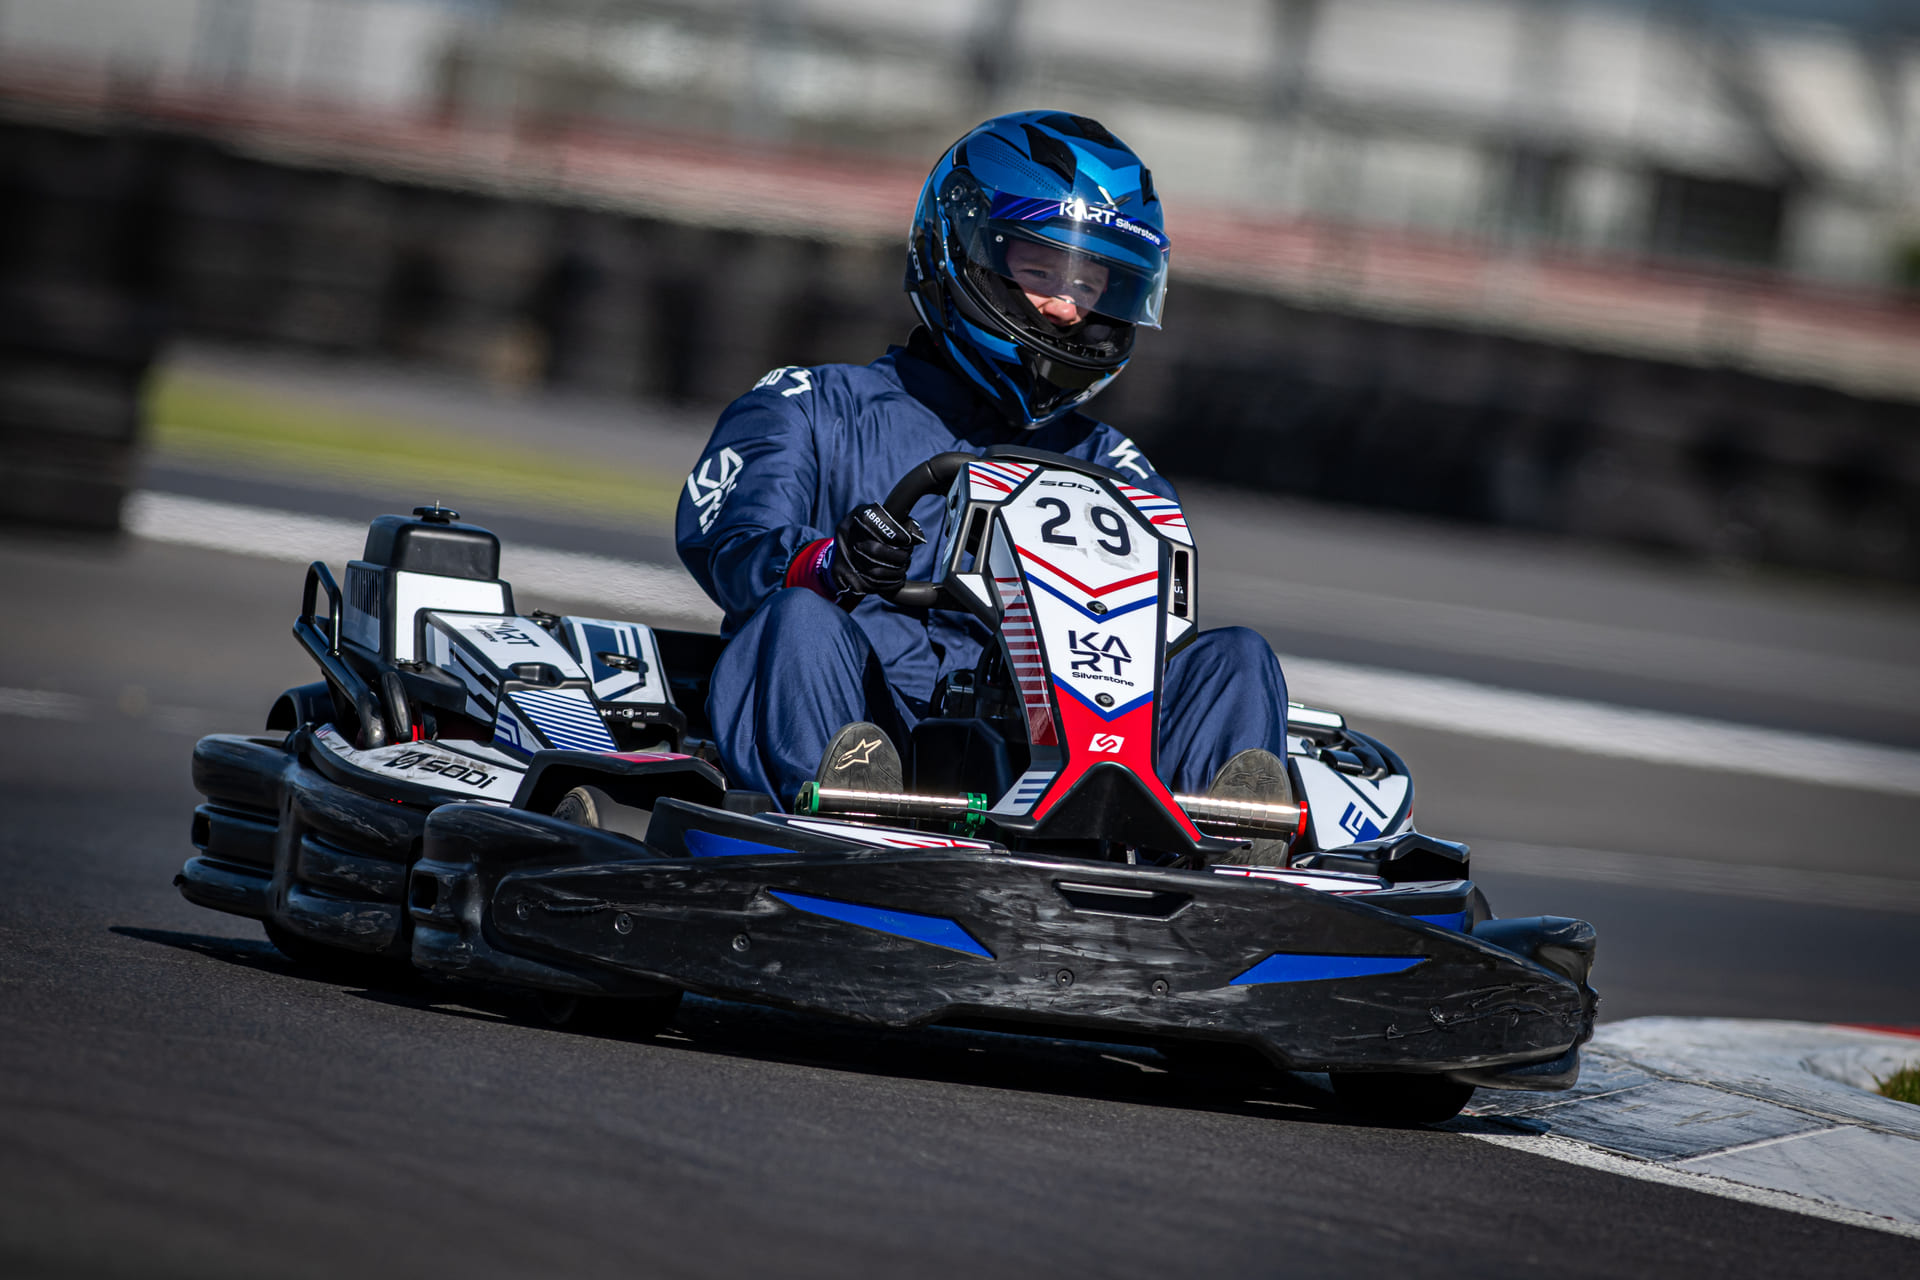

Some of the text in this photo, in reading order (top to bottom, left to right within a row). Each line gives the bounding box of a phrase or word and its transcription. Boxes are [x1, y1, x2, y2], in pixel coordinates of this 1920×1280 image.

[1059, 199, 1161, 246] KART Silverstone
[864, 508, 897, 540] ABRUZZI
[1035, 497, 1132, 556] 29
[1071, 671, 1135, 687] Silverstone
